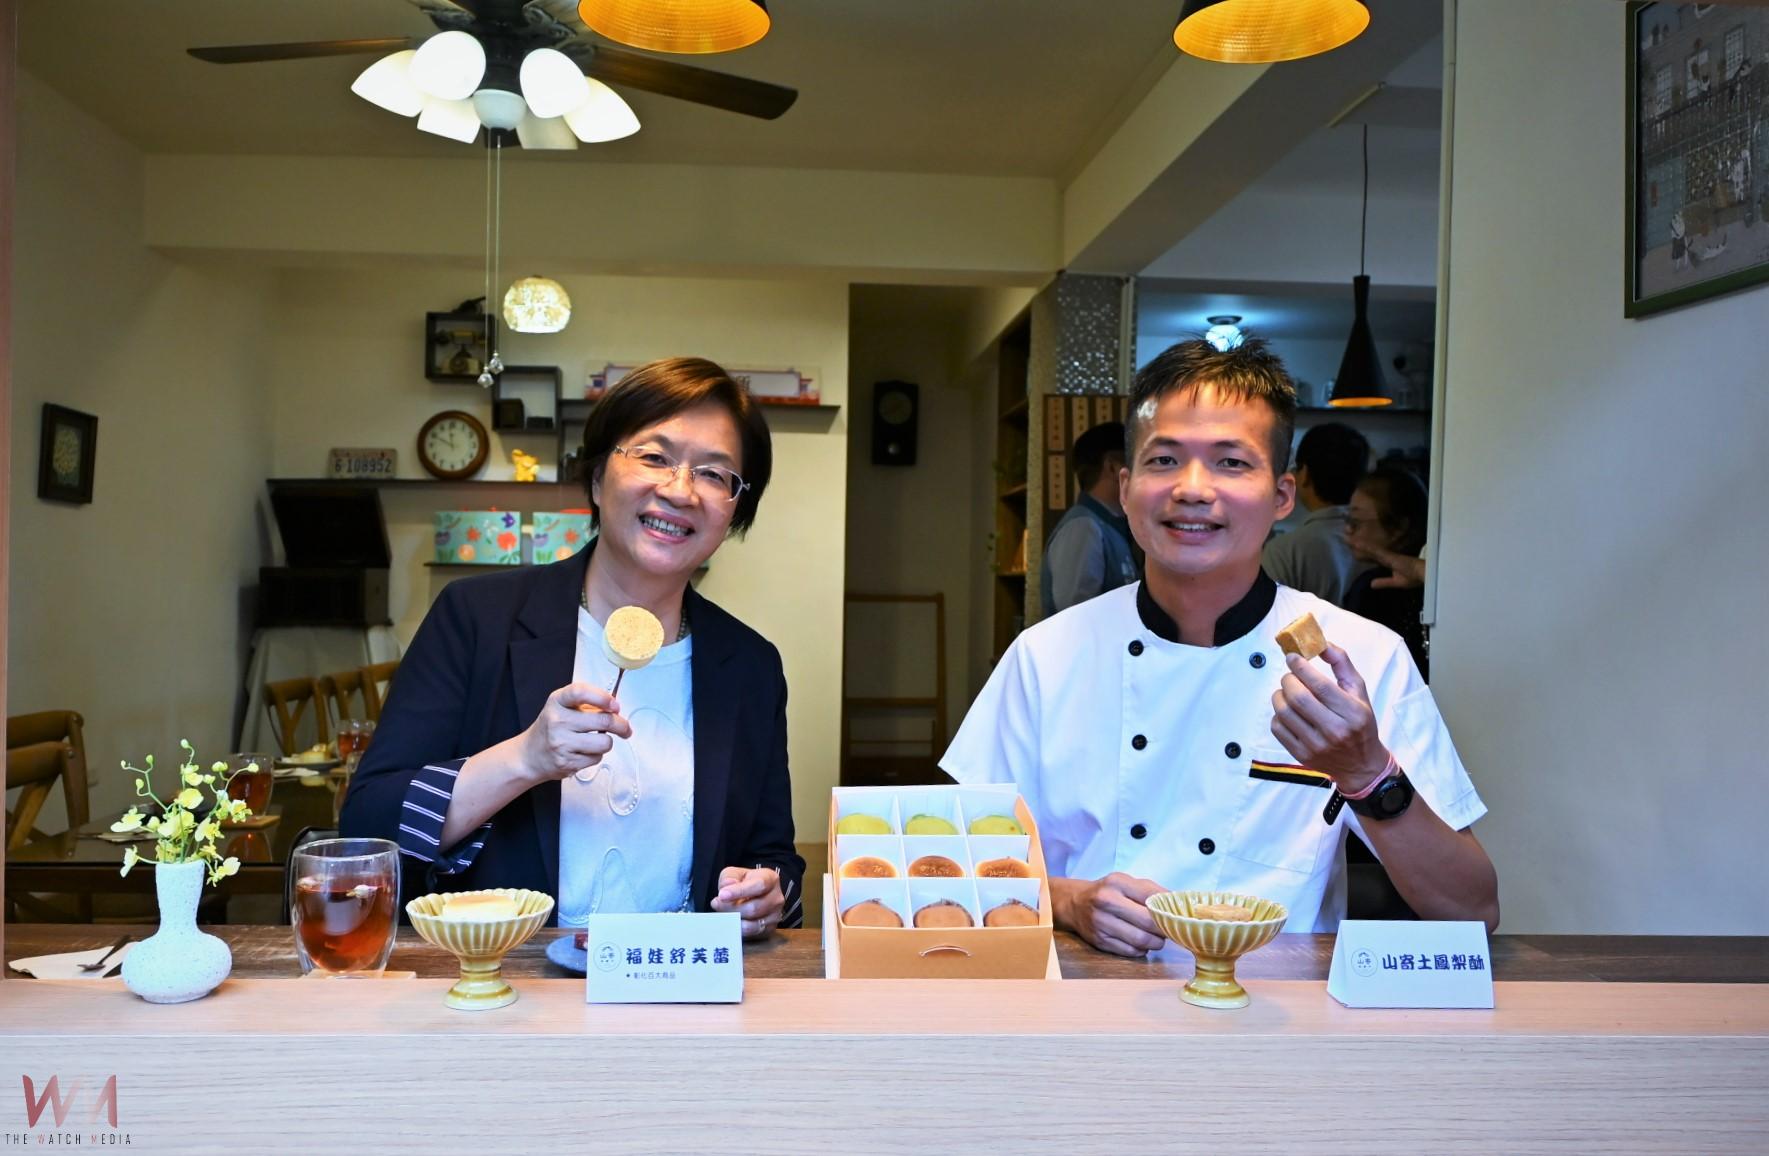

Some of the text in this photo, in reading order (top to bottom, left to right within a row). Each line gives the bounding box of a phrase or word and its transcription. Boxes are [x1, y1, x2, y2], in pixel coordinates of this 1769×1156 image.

[626, 947, 729, 965] 福娃舒芙蕾
